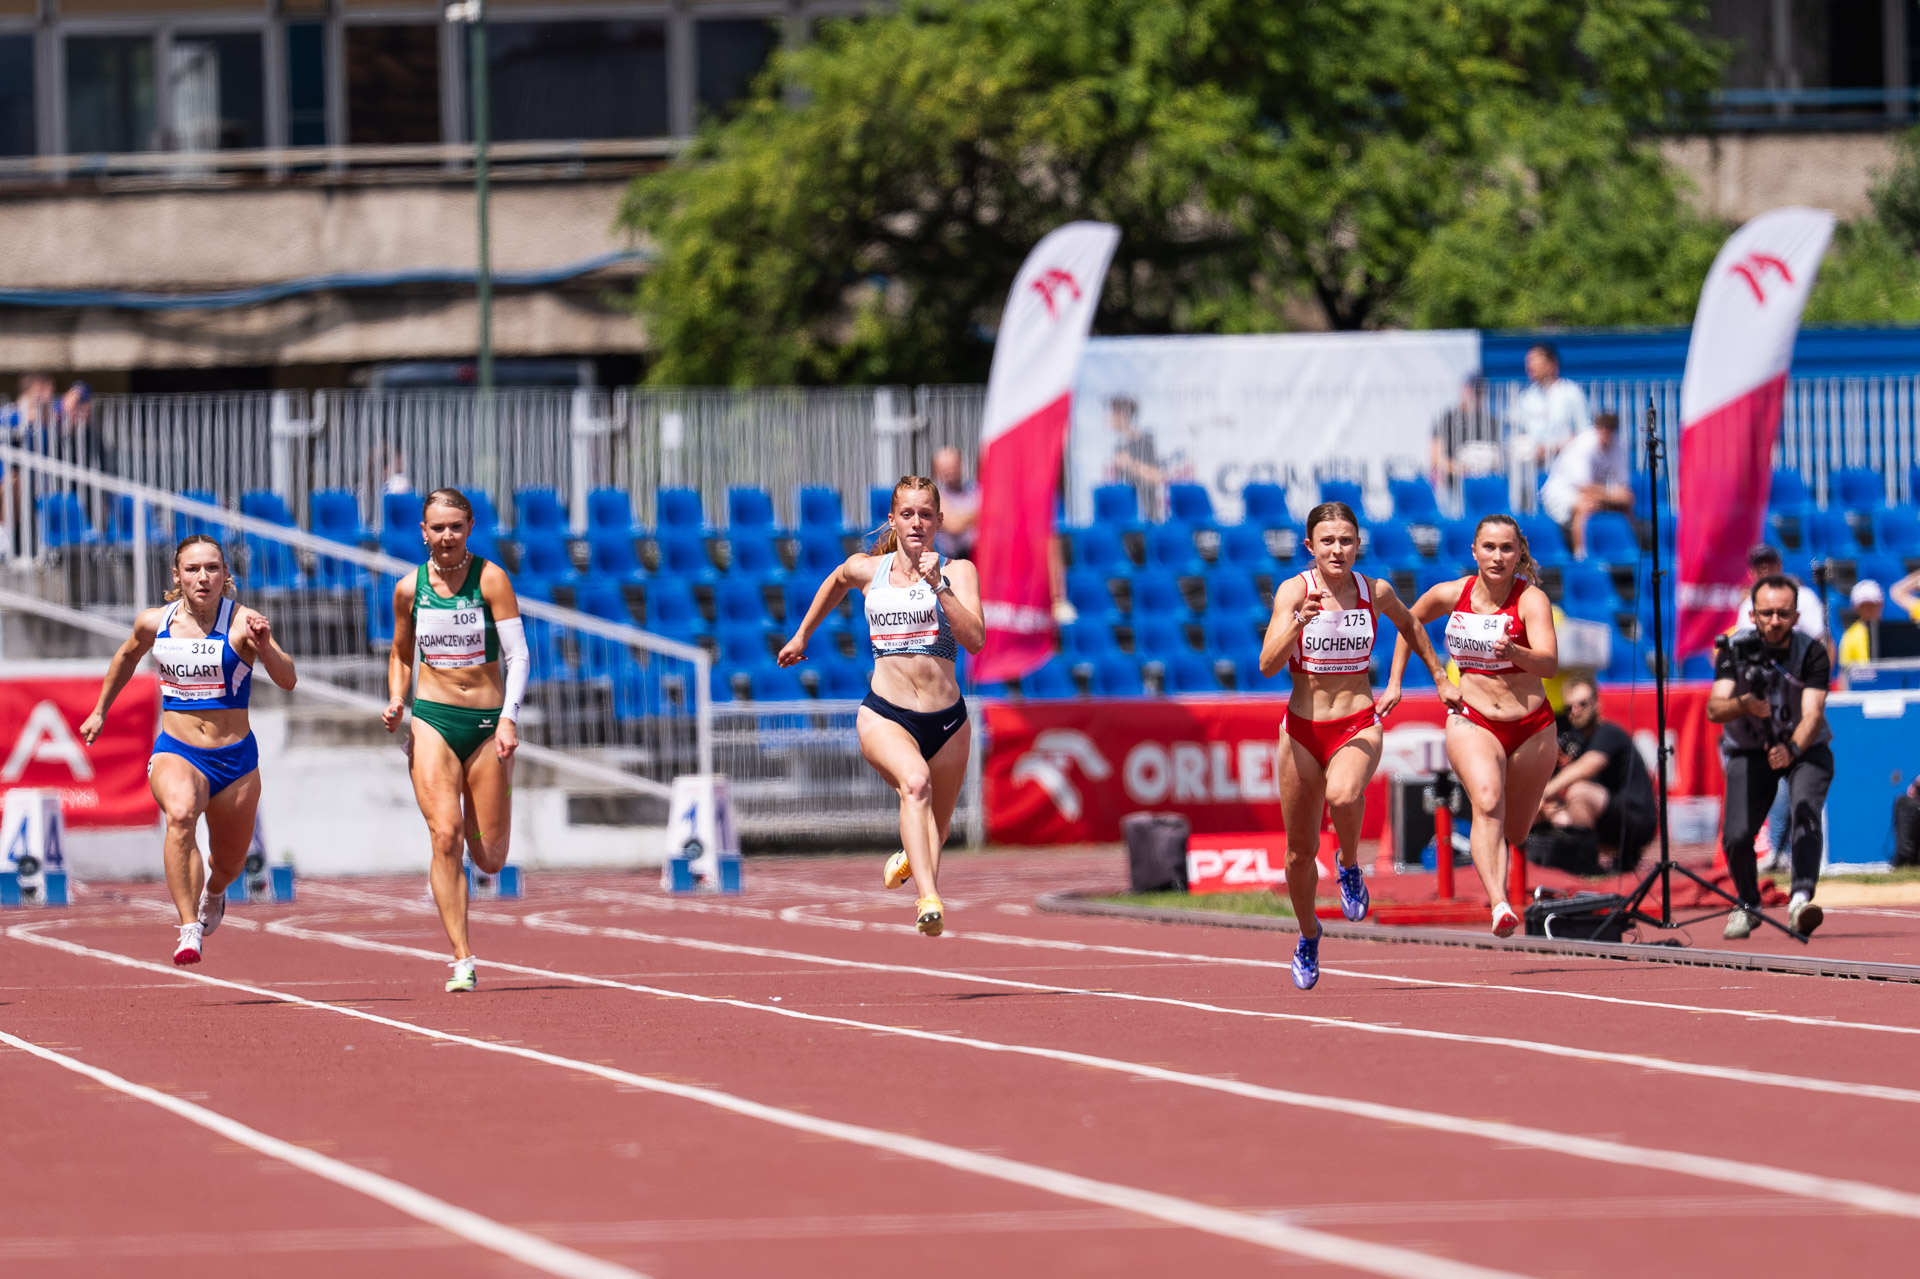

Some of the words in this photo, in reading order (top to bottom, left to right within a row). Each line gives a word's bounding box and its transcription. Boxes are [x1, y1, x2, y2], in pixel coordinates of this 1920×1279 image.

[910, 590, 924, 600] 95
[453, 612, 477, 625] 108
[870, 610, 935, 626] MOCZERNIUK
[1344, 614, 1366, 627] 175
[1483, 619, 1498, 630] 84
[420, 634, 482, 647] ADAMCZEWSKA
[1305, 636, 1370, 651] SUCHENEK
[191, 643, 216, 654] 316
[160, 664, 219, 677] ANGLART
[1122, 738, 1281, 803] ORLE
